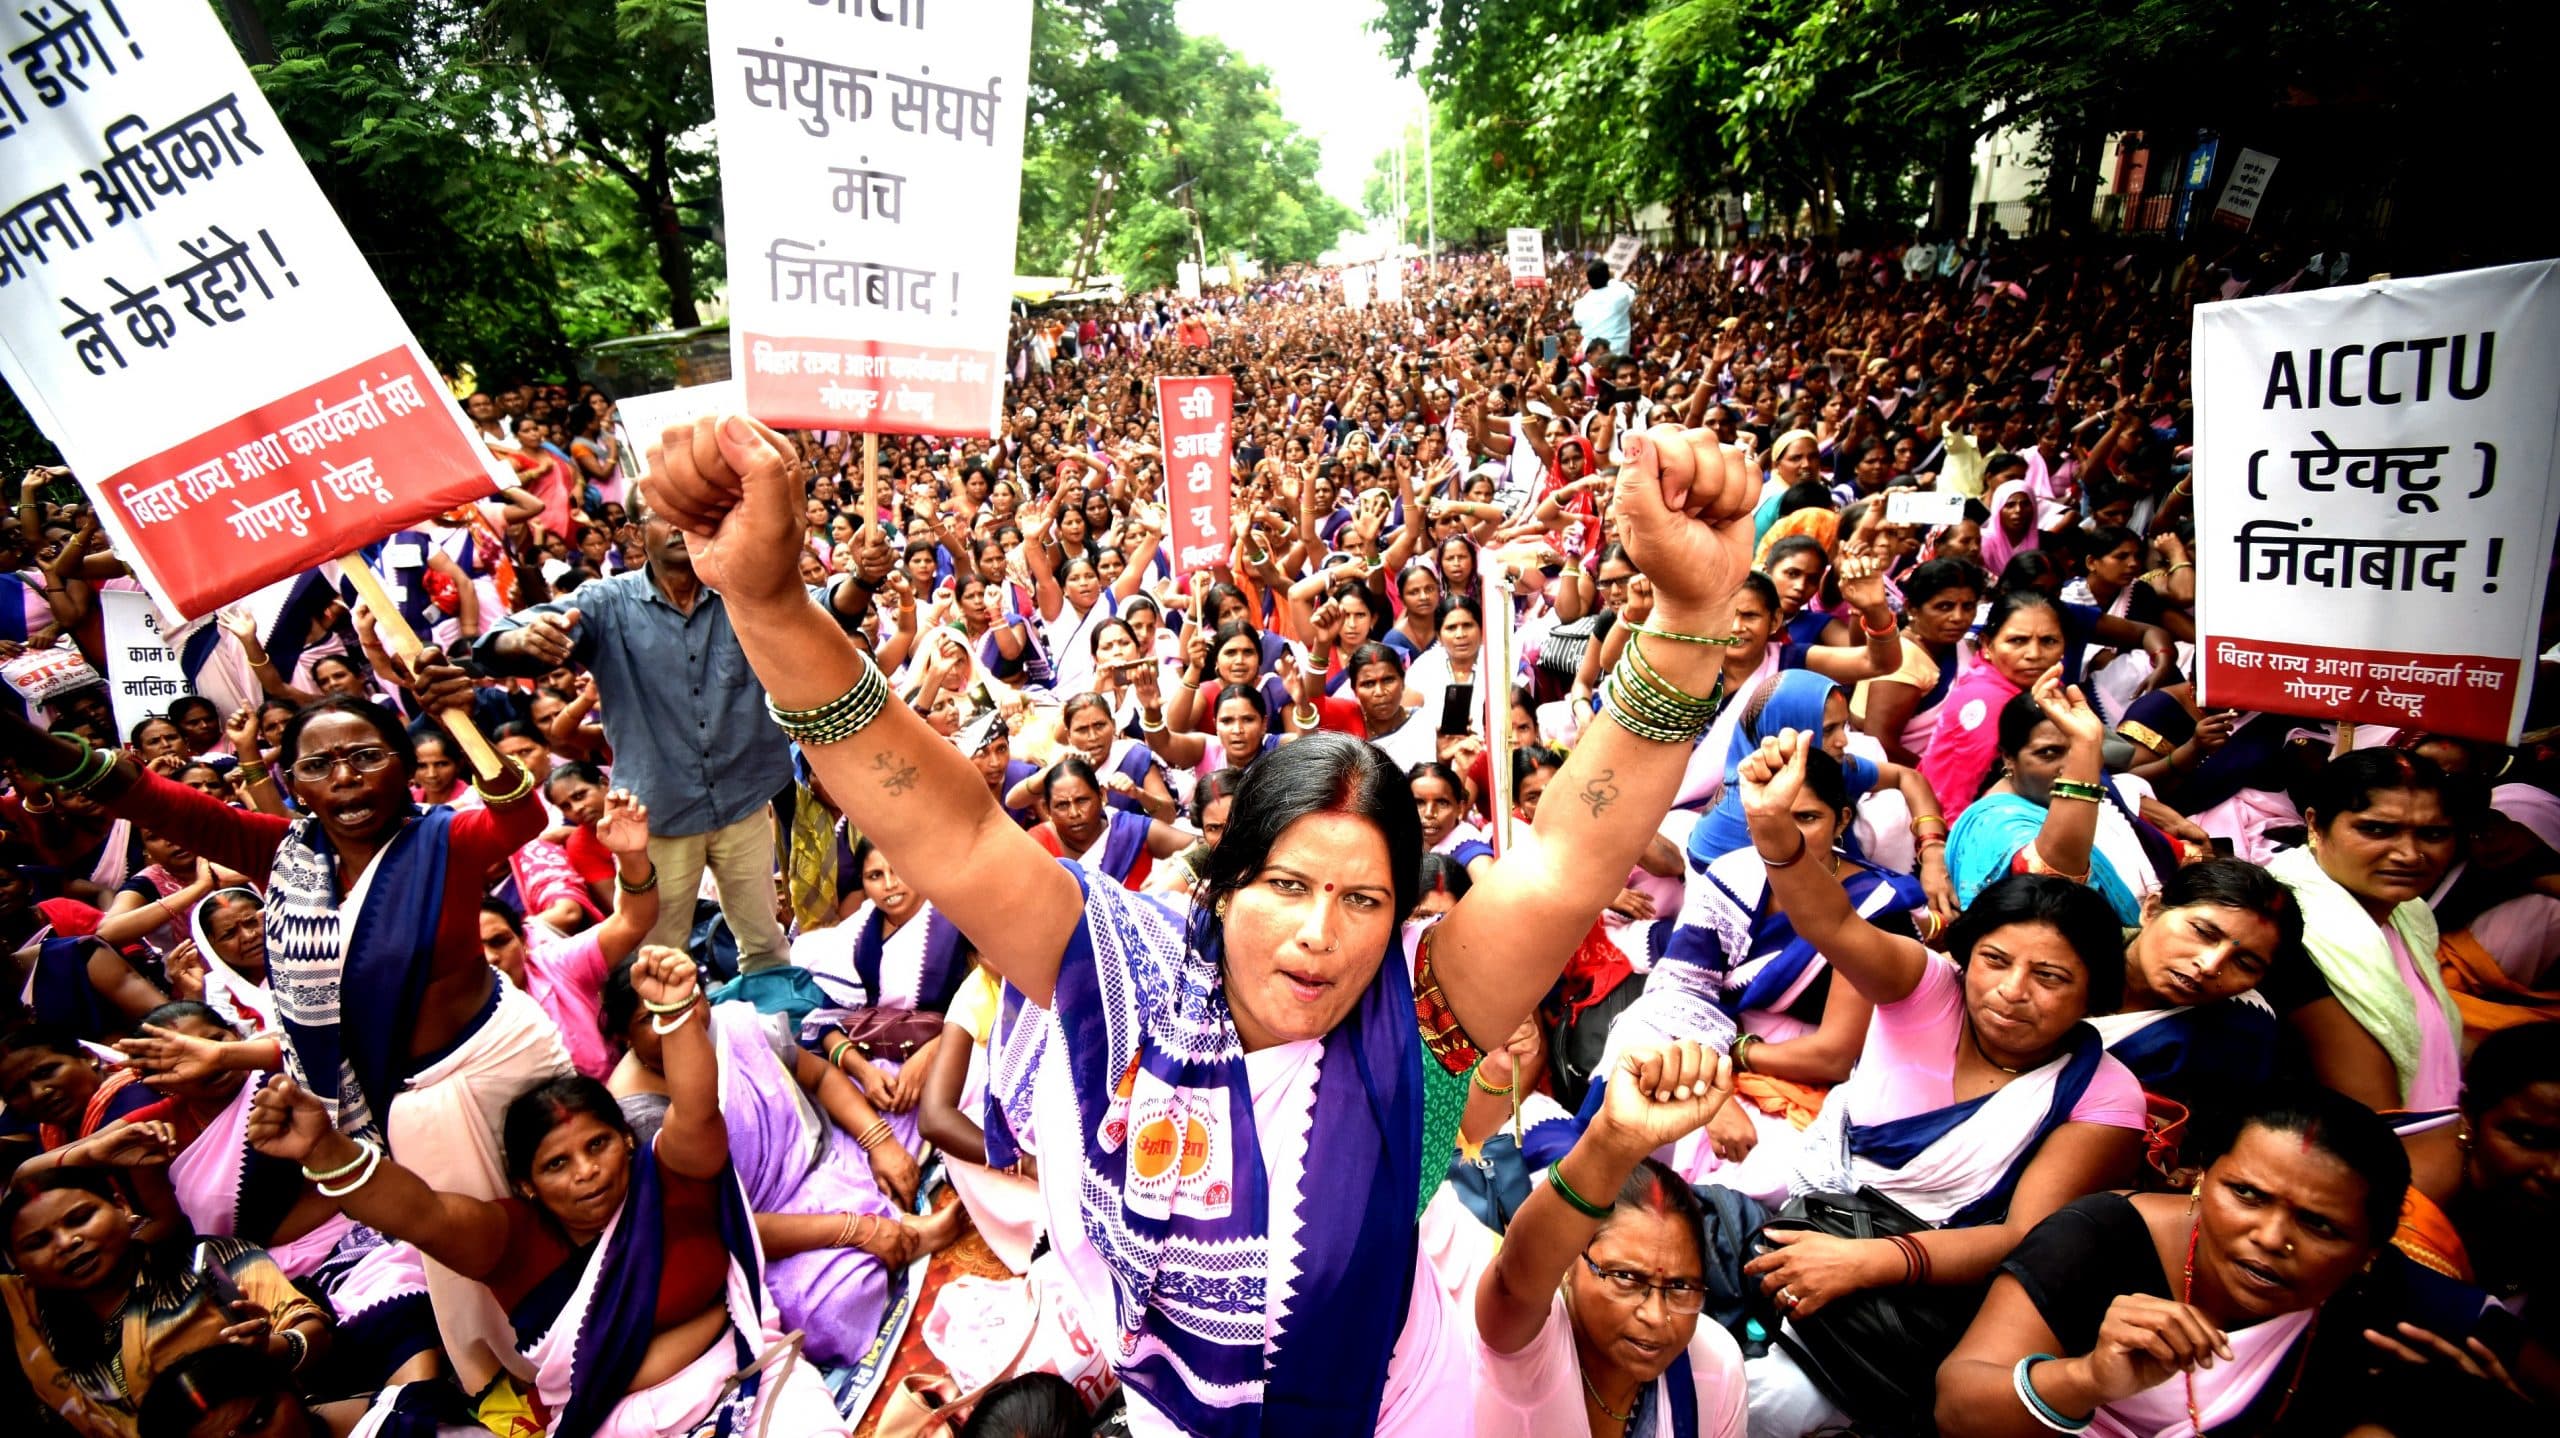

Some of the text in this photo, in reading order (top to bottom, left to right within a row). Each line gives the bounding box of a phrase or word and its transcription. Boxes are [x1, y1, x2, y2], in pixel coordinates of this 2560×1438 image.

[8, 0, 117, 108] डरेंगे
[737, 37, 1002, 146] संयुक्त संघर्ष
[80, 92, 264, 228] अधिकार
[827, 155, 906, 224] मंच
[60, 297, 128, 376] ले
[104, 277, 176, 349] के
[164, 225, 274, 327] रहेंगे
[765, 238, 936, 314] जिंदाबाद
[845, 354, 886, 378] आशा
[2263, 331, 2496, 410] AICCTU
[1178, 386, 1214, 419] सी
[118, 371, 426, 528] बिहार राज्य आशा कार्यकर्ता संघ
[1173, 422, 1225, 459] आई
[2290, 430, 2449, 514] ऐक्टू
[225, 488, 311, 542] गोपगुट
[1190, 505, 1217, 537] यू
[2233, 517, 2466, 593] जिंदाबाद
[121, 675, 177, 696] मासिक
[127, 646, 162, 663] काम
[2216, 641, 2504, 690] बिहार राज्य आशा कार्यकर्ता संघ
[2283, 678, 2353, 706] गोपगुट
